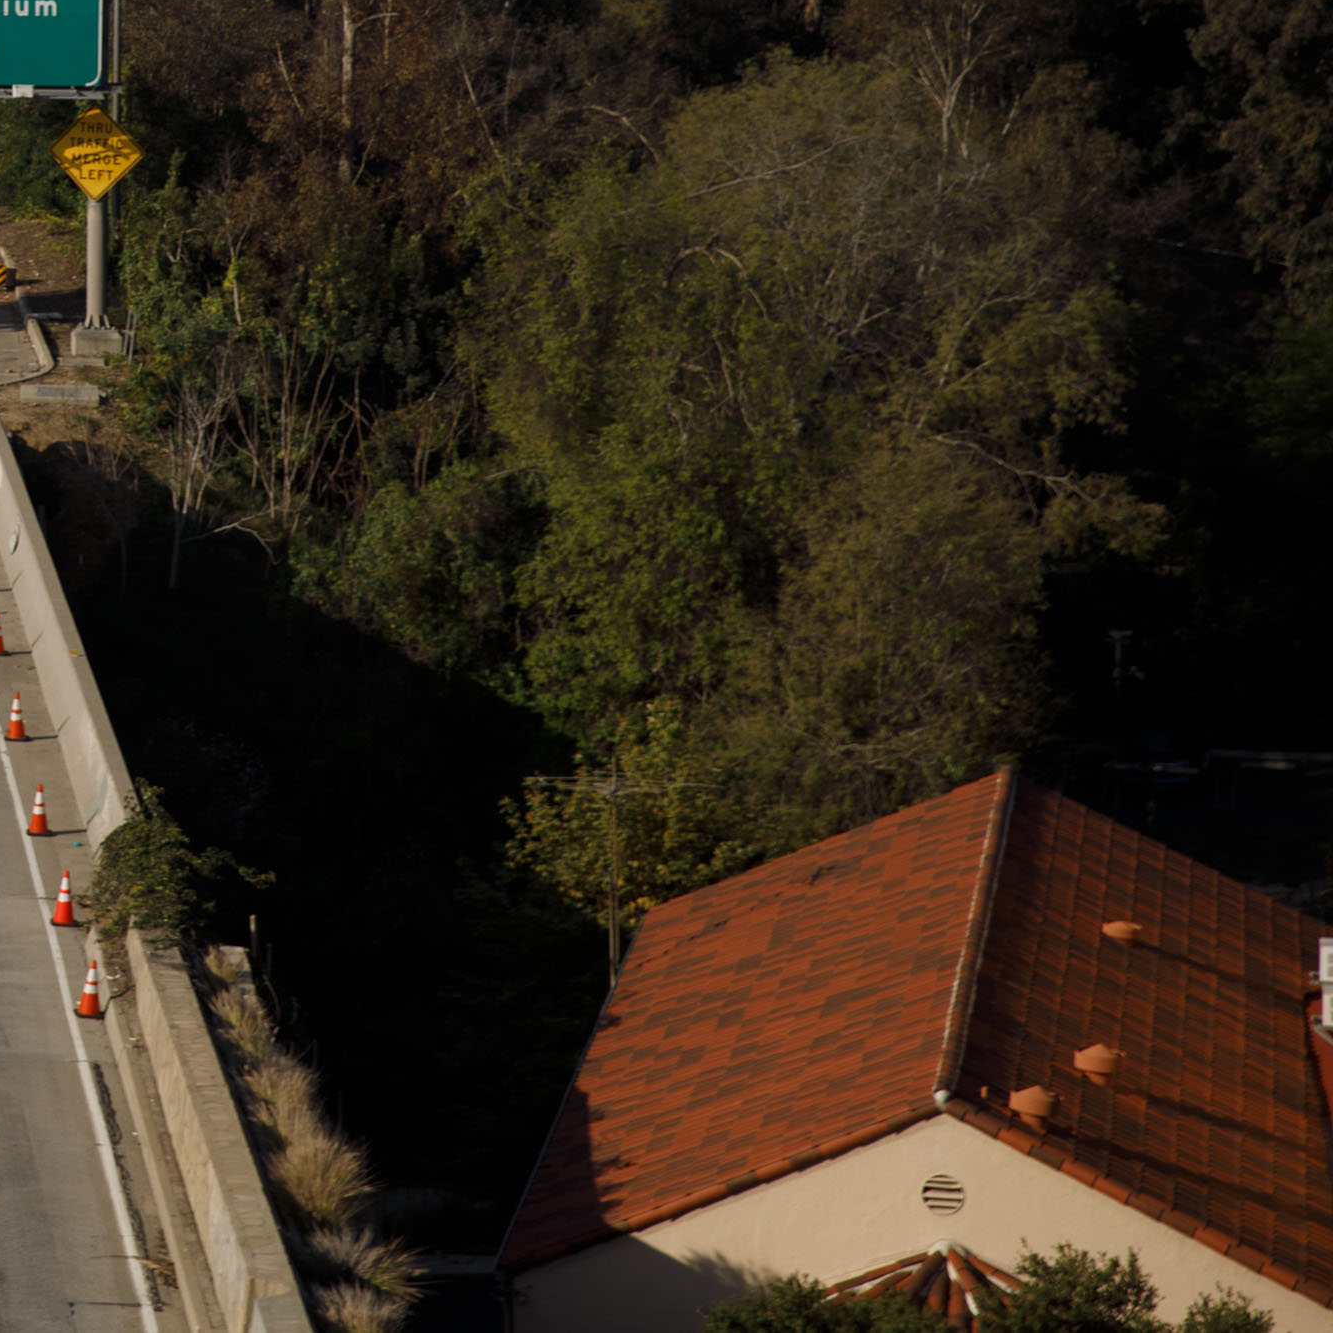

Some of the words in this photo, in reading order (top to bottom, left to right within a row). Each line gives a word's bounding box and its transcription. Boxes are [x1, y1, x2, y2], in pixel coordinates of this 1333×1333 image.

[80, 122, 113, 133] THRU
[70, 137, 122, 149] TRAFFIC
[72, 153, 122, 165] MERGE
[79, 169, 114, 180] LEFT
